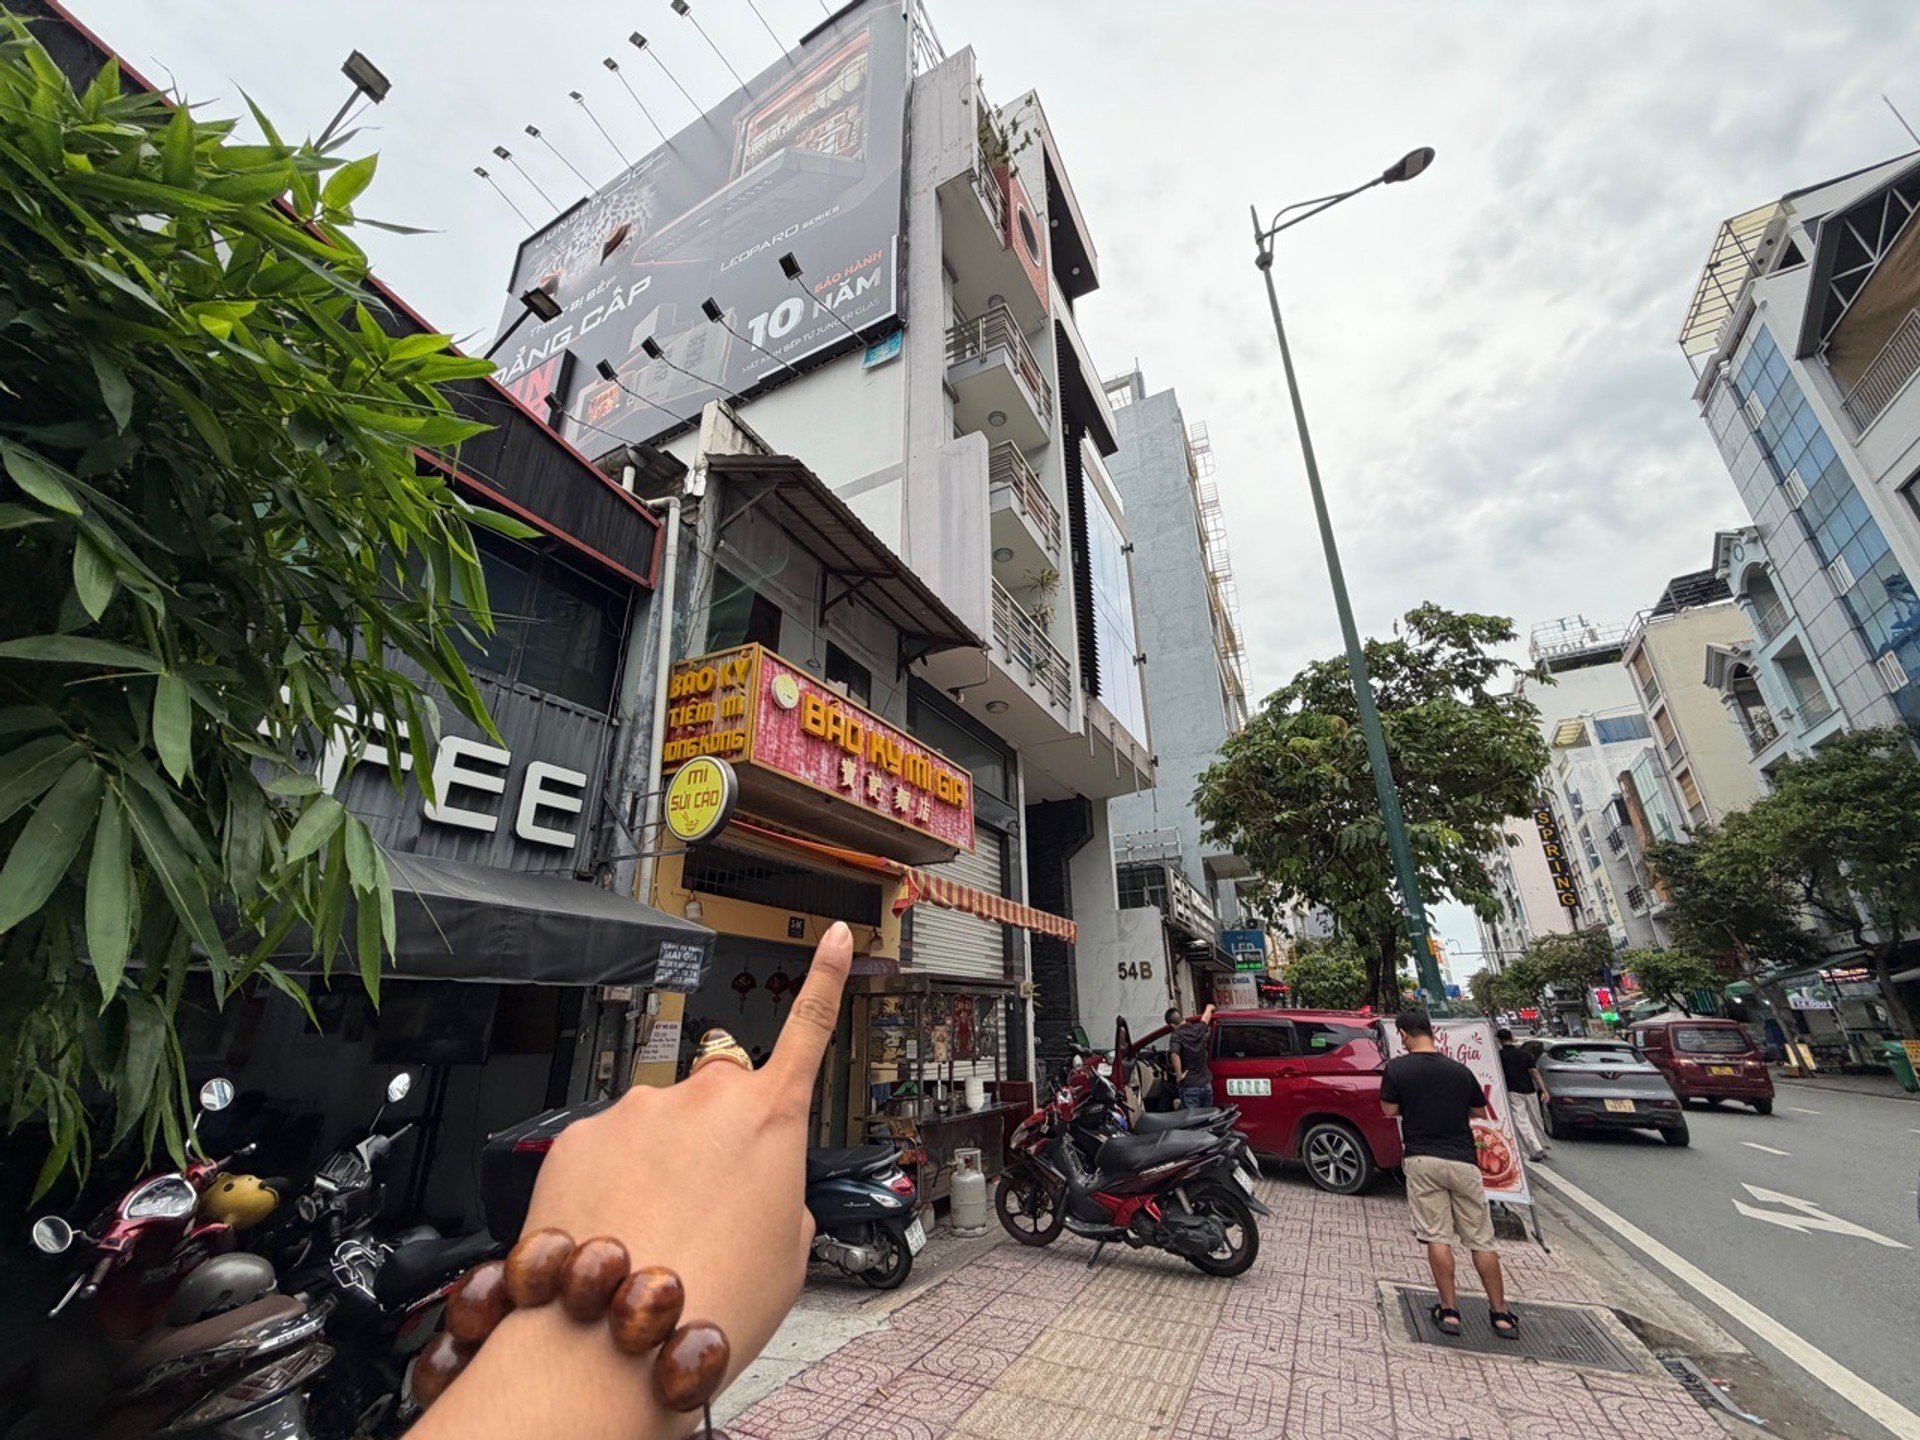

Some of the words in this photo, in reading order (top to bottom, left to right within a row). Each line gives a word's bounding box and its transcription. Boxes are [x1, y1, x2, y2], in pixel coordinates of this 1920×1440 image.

[720, 224, 799, 271] LEOPARD
[580, 276, 652, 336] CẤP
[747, 297, 804, 352] 10
[812, 266, 882, 319] NĂM
[801, 692, 864, 757] BẢO
[934, 768, 967, 810] GIA
[1537, 812, 1577, 906] SPRING
[1117, 961, 1153, 980] 54B
[1457, 1043, 1481, 1065] Gia
